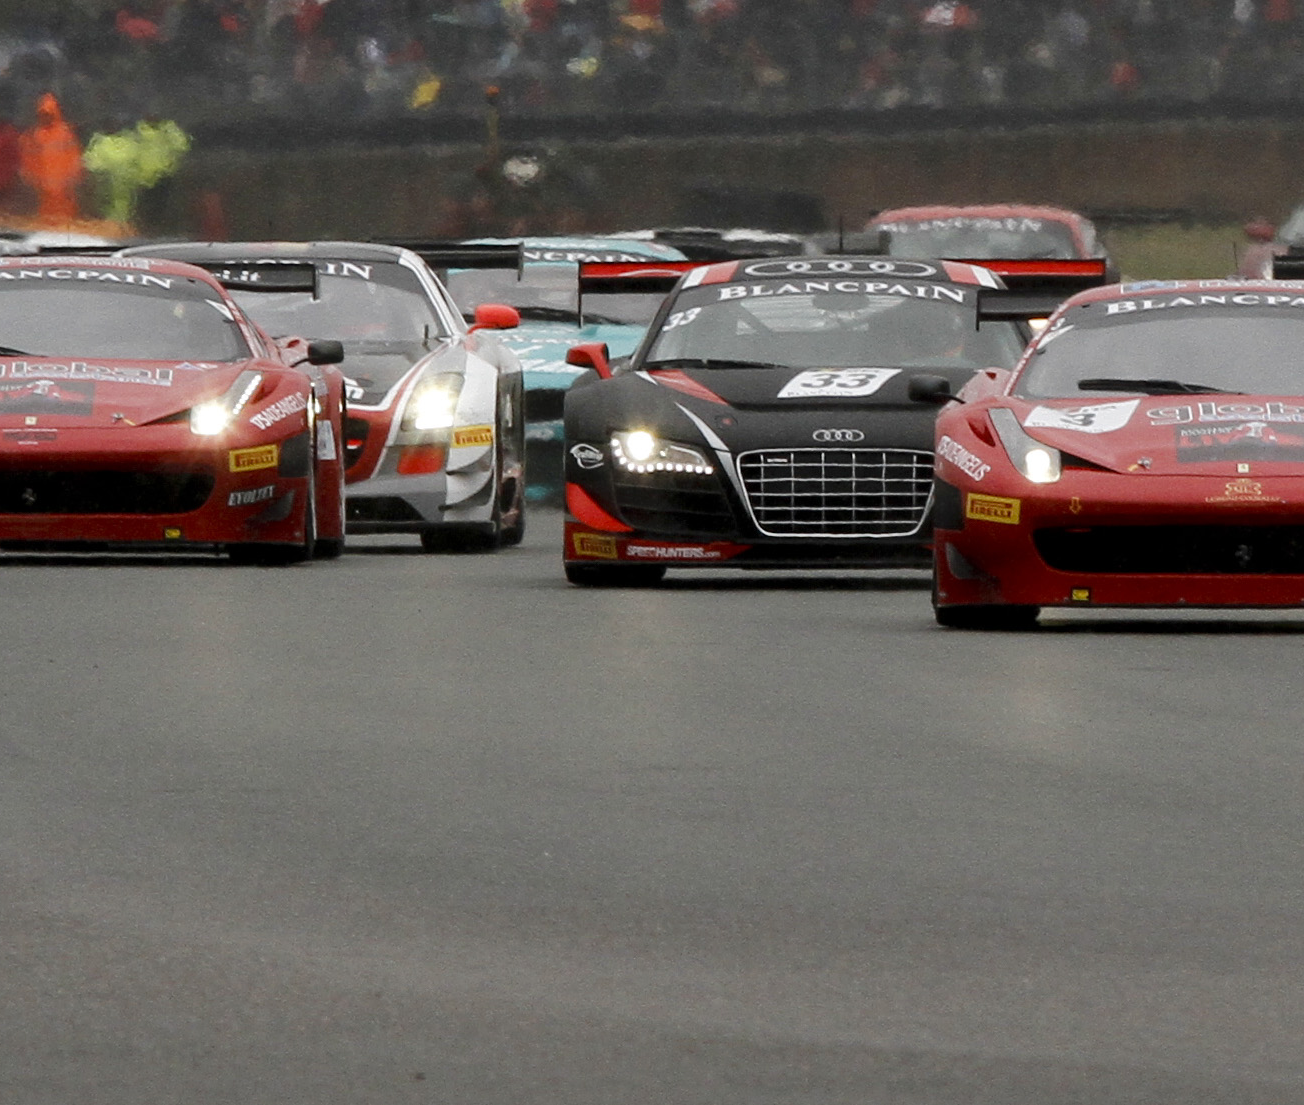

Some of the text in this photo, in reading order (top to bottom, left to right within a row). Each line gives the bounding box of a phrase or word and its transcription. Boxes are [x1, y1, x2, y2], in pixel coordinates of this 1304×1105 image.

[719, 281, 966, 303] BLANCPAIN
[662, 308, 701, 332] 33
[800, 372, 876, 390] 33
[233, 451, 275, 469] PIRELLI
[970, 499, 1014, 518] PIRELLI
